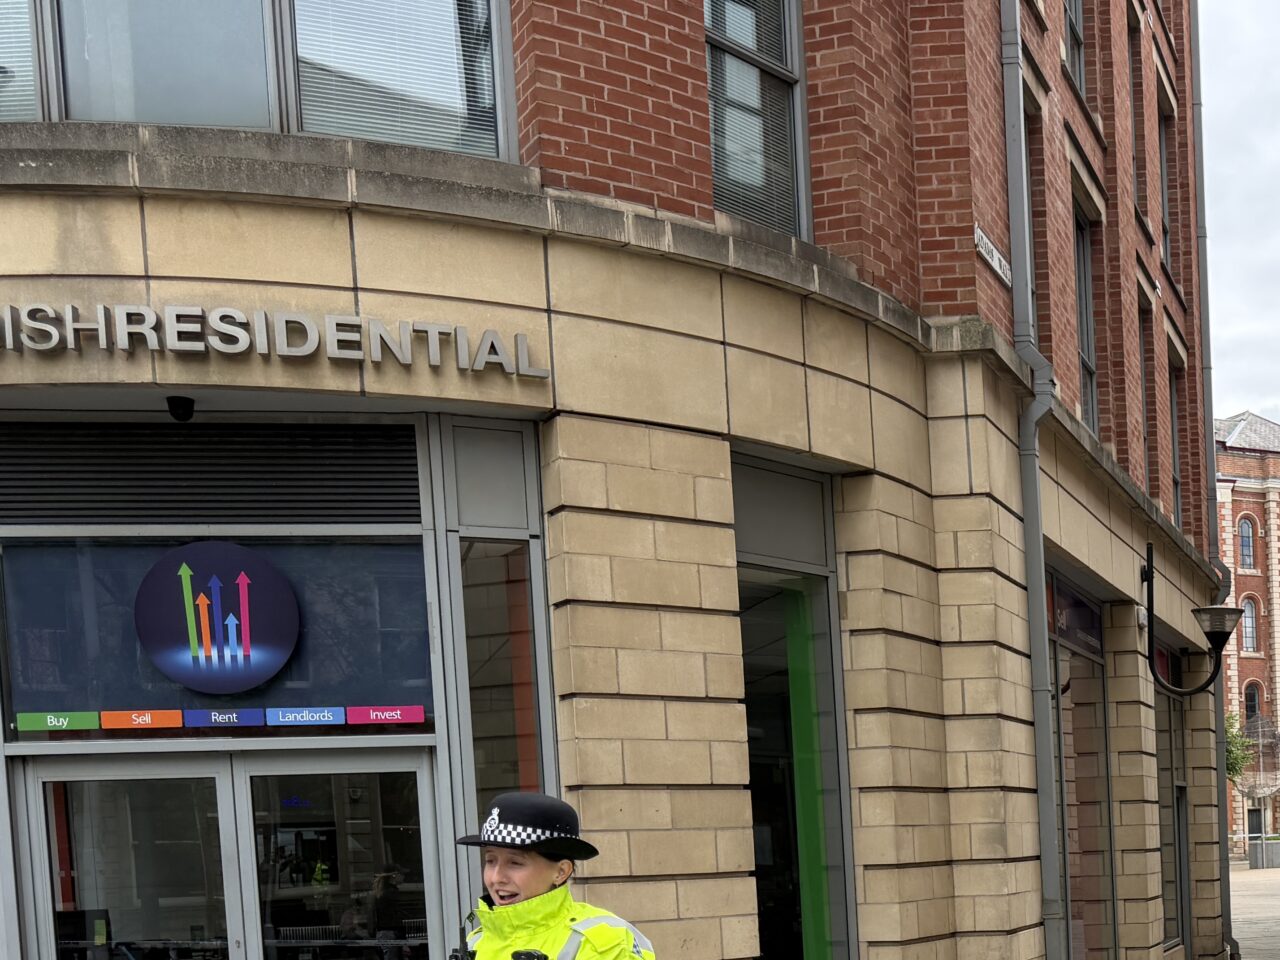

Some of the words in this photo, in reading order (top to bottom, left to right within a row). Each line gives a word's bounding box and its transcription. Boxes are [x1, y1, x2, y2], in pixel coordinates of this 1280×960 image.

[47, 714, 69, 728] Buy
[131, 712, 151, 724] Sell
[211, 711, 238, 724] Rent
[279, 709, 334, 722] Landlords
[370, 708, 402, 721] Invest
